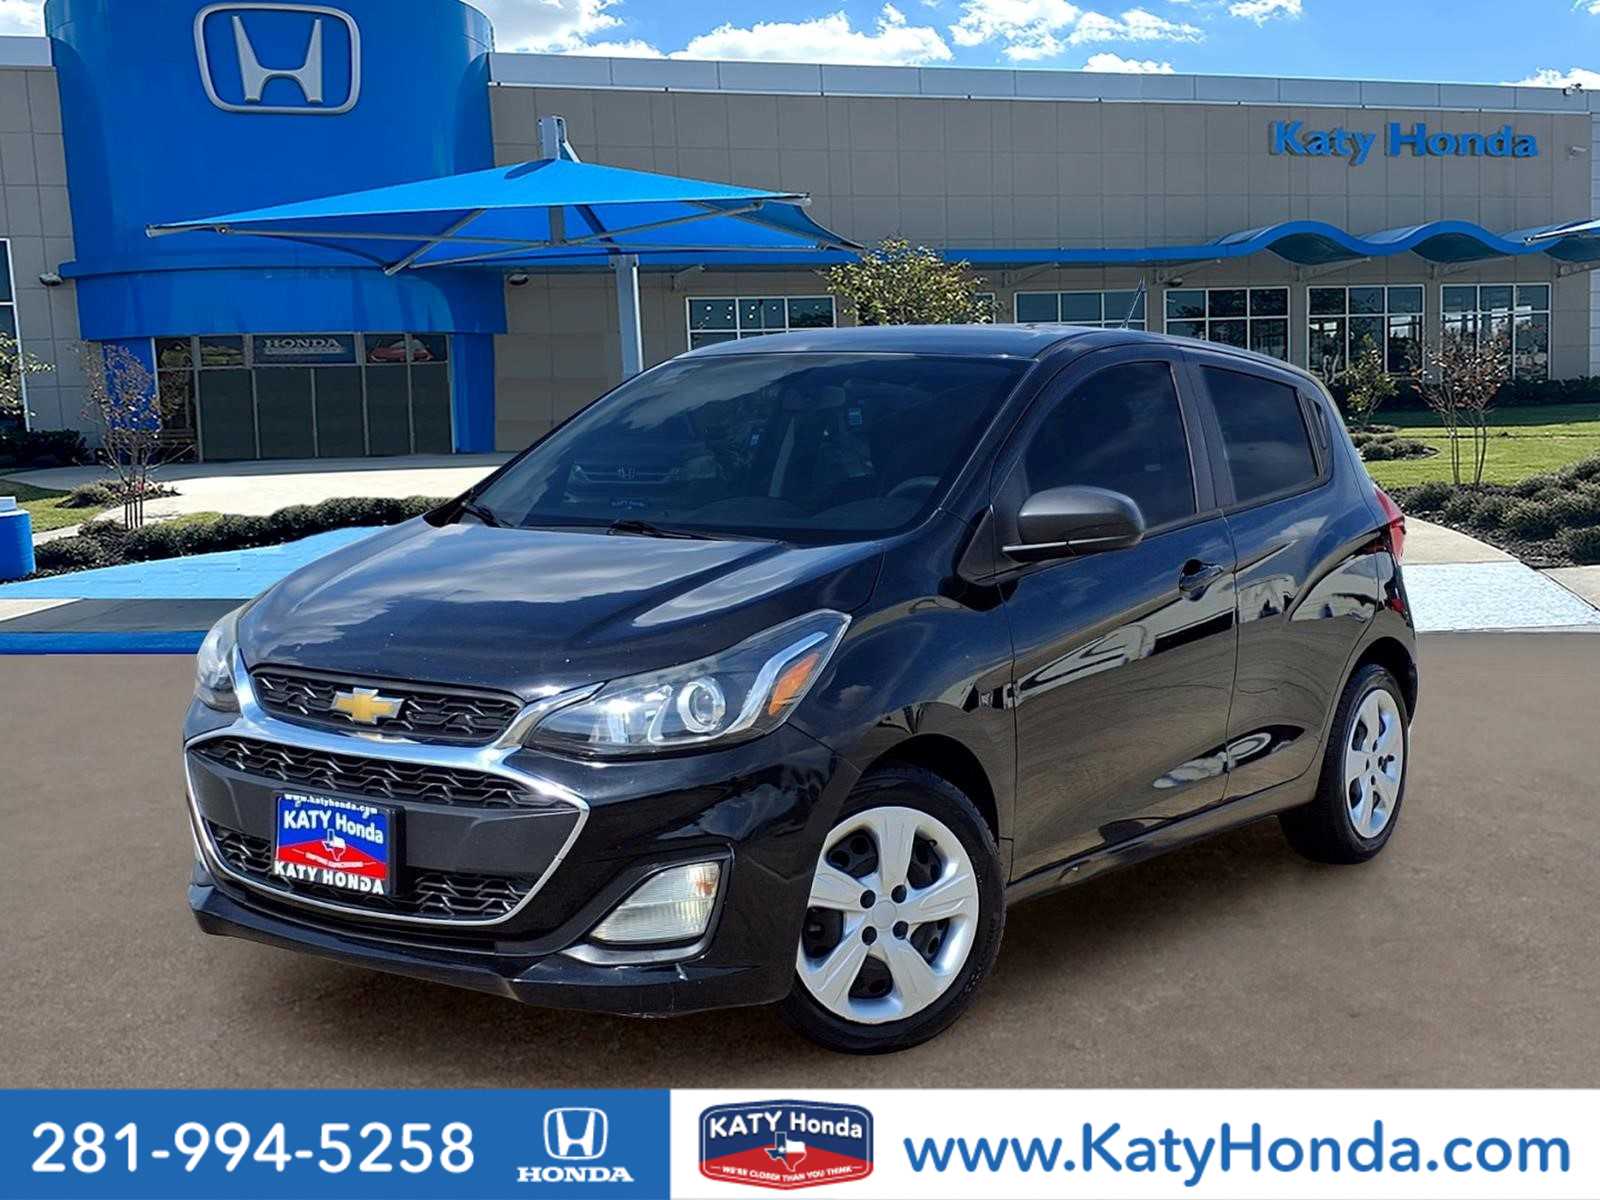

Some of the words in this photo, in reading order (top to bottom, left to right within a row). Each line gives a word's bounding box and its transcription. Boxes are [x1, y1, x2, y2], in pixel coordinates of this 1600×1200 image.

[1269, 120, 1376, 166] Katy
[1385, 122, 1538, 158] Honda
[264, 338, 341, 348] HONDA
[283, 810, 332, 829] KATY
[335, 812, 384, 844] Honda
[274, 860, 318, 881] KATY
[322, 869, 384, 895] HONDA
